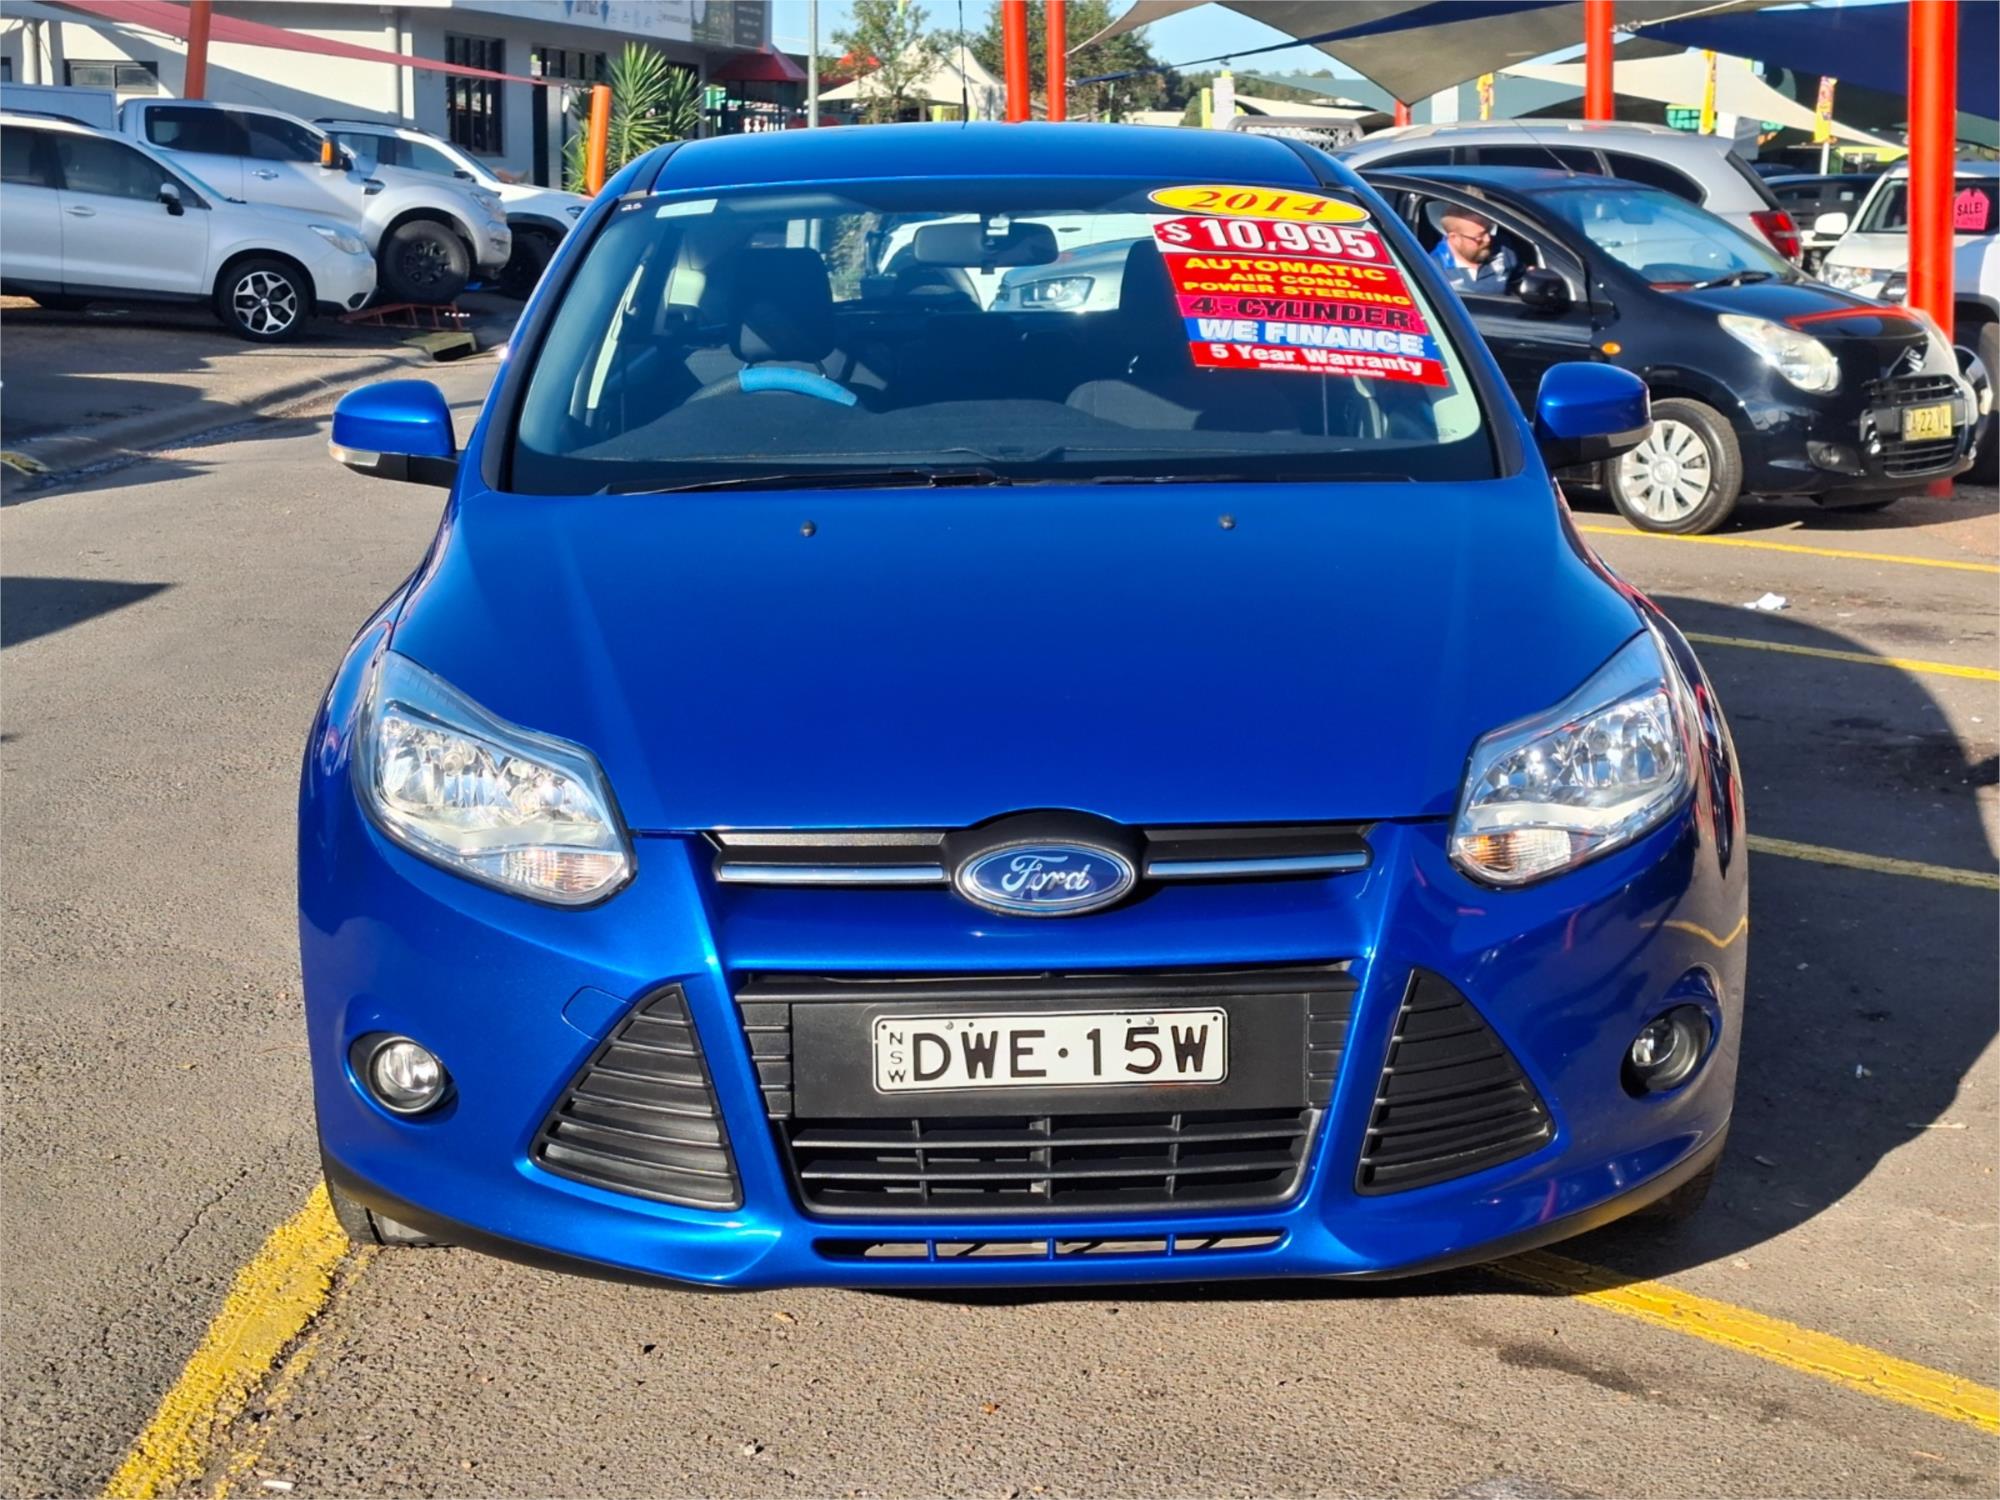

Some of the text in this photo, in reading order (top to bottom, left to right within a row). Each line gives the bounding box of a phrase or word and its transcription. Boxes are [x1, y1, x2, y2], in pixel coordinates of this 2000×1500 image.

[1188, 190, 1328, 216] 2014
[1185, 257, 1387, 281] AUTOMATIC
[1230, 273, 1360, 289] AIR COND.
[1183, 281, 1411, 305] POWER STEERING
[1197, 318, 1425, 357] WE FINANCE
[1210, 344, 1422, 376] 5 Year Warranty
[1001, 854, 1092, 892] Ford
